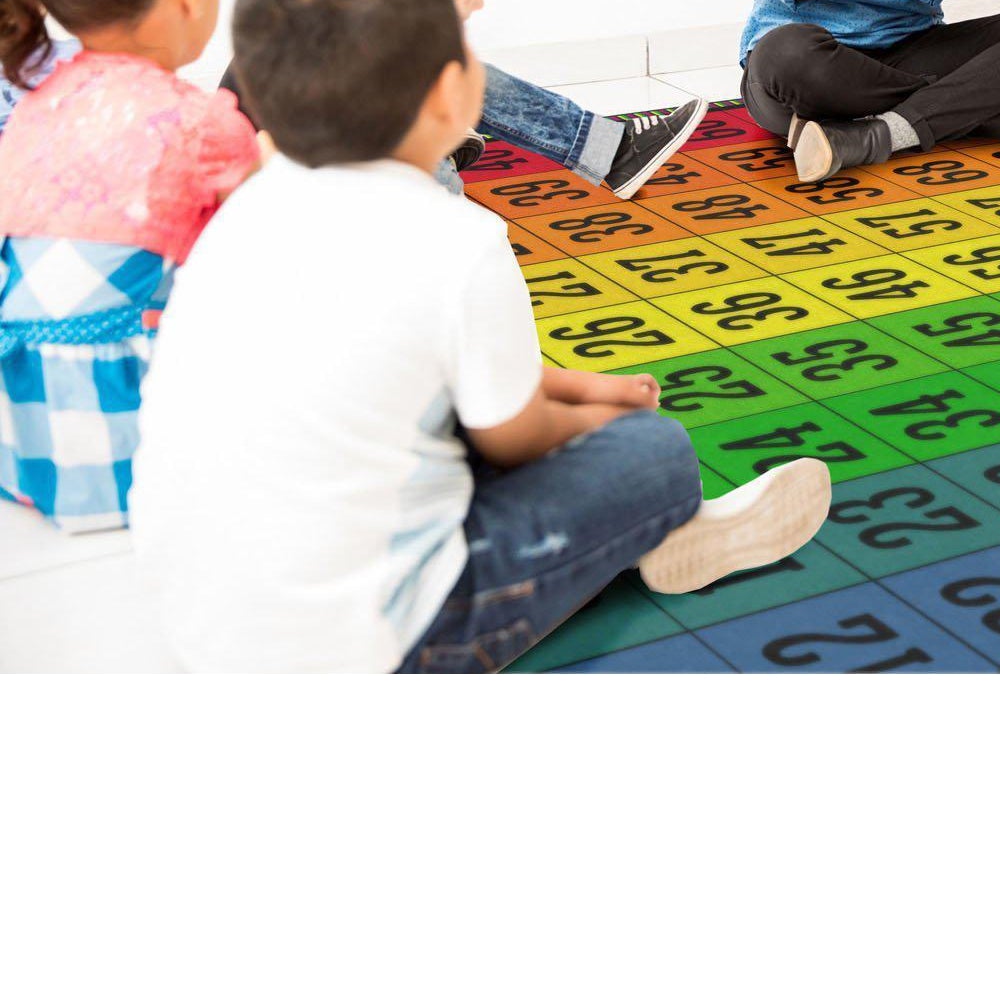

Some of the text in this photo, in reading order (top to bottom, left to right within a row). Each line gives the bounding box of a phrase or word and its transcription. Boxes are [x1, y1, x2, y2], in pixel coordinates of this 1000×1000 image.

[718, 146, 793, 173] 59
[893, 160, 990, 186] 68
[490, 180, 589, 207] 39
[784, 176, 884, 205] 58
[672, 195, 769, 220] 48
[549, 212, 653, 242] 38
[855, 209, 962, 239] 57
[740, 229, 847, 256] 47
[615, 250, 729, 283] 37
[822, 269, 930, 300] 46
[691, 292, 809, 330] 36
[549, 317, 675, 357] 26
[771, 339, 898, 381] 35
[659, 365, 769, 413] 25
[720, 420, 868, 475] 24
[827, 487, 981, 549] 23
